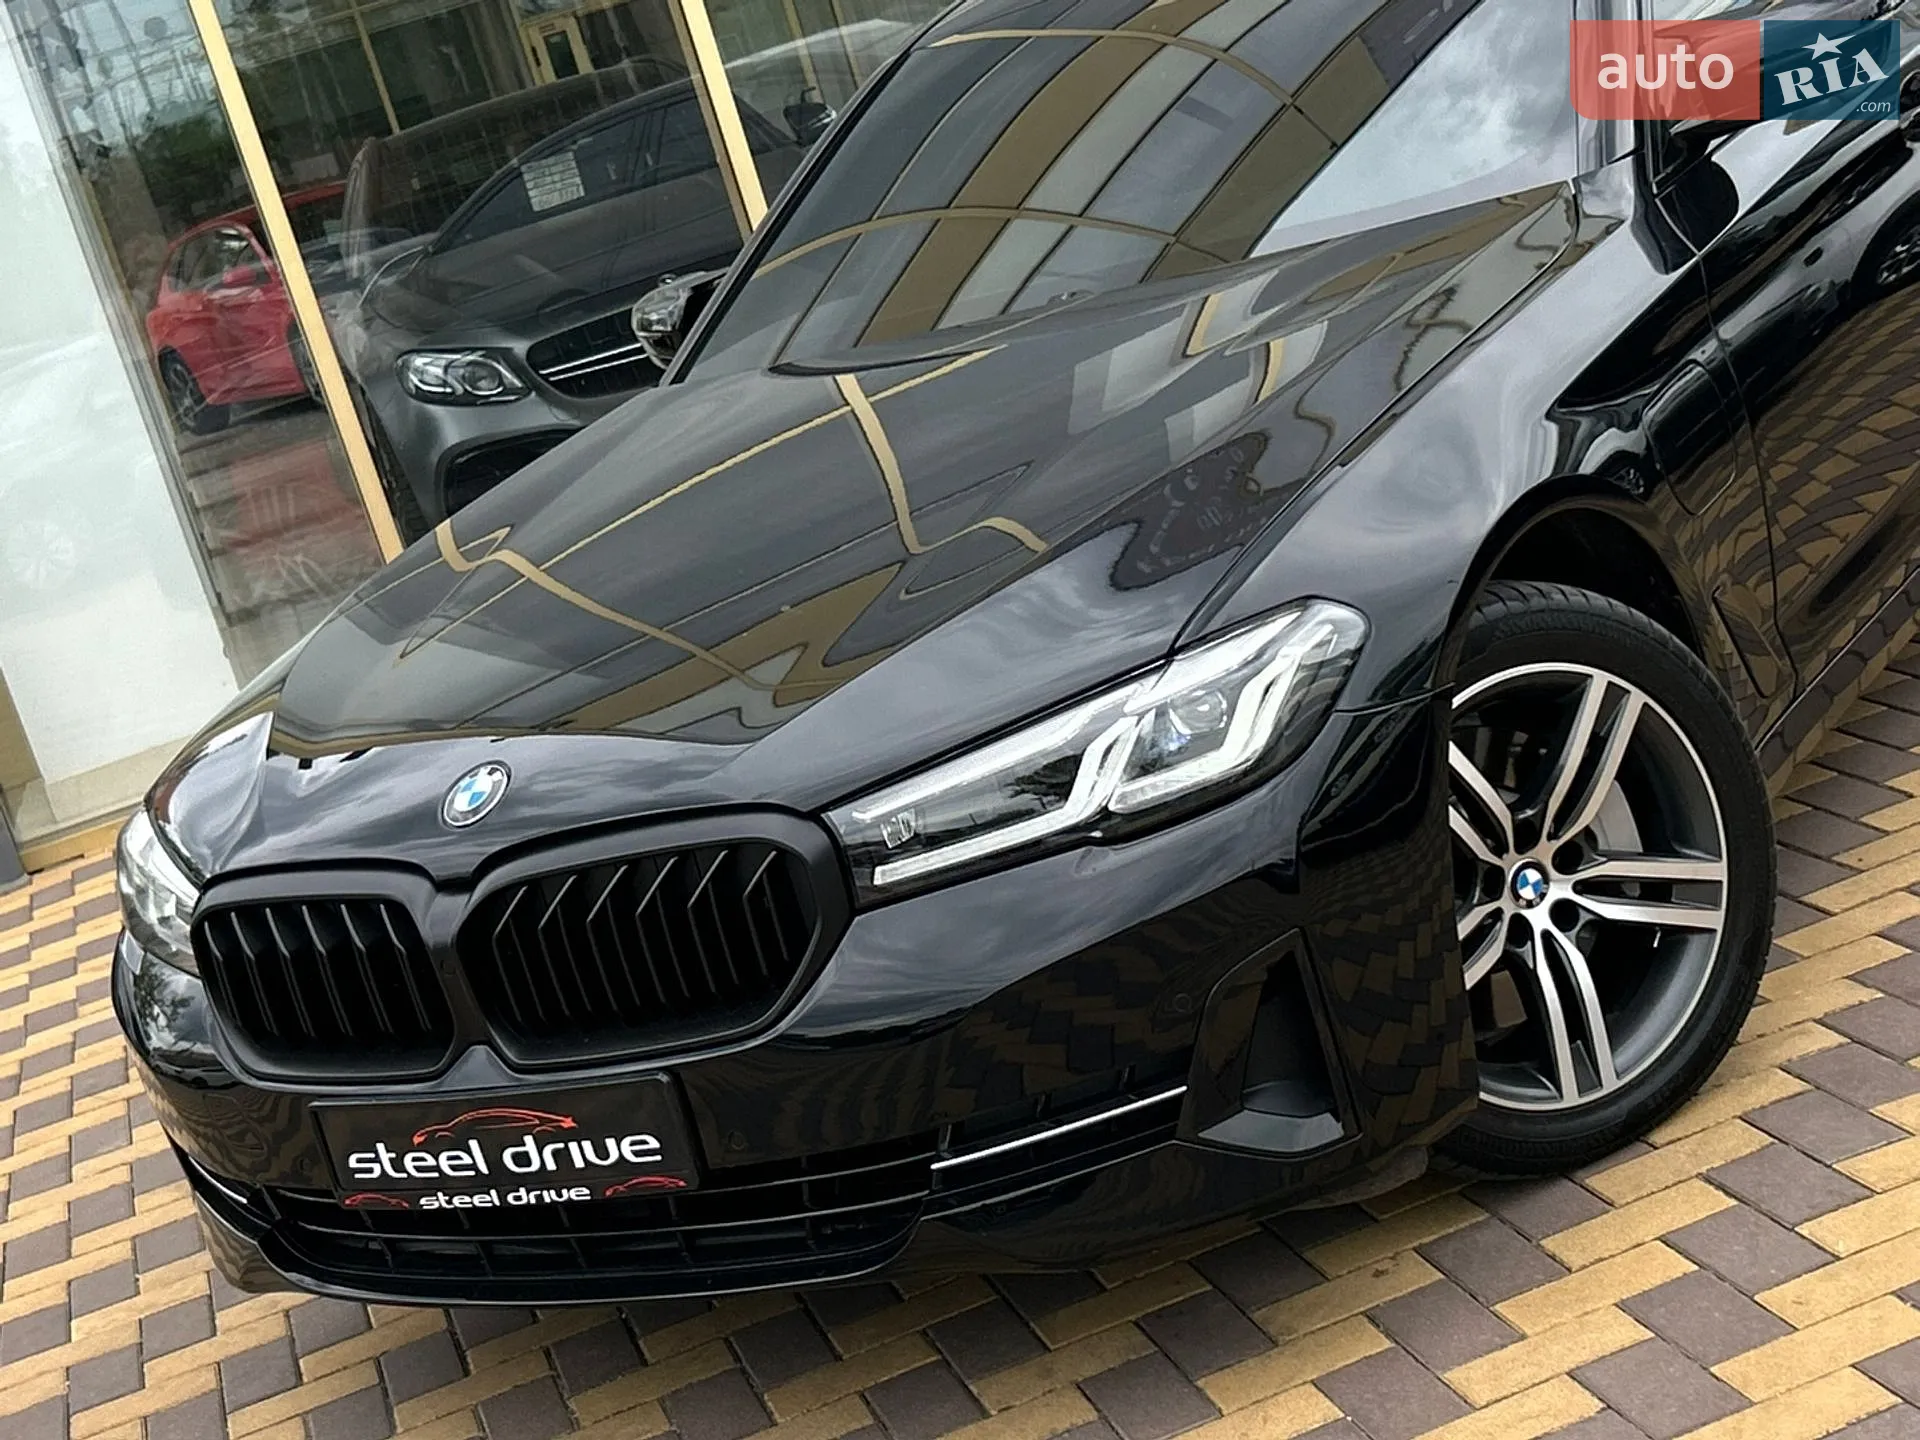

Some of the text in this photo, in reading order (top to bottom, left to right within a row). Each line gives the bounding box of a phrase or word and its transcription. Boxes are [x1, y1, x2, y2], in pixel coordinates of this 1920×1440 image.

[349, 1134, 662, 1178] steel drive
[420, 1187, 591, 1209] steel drive
